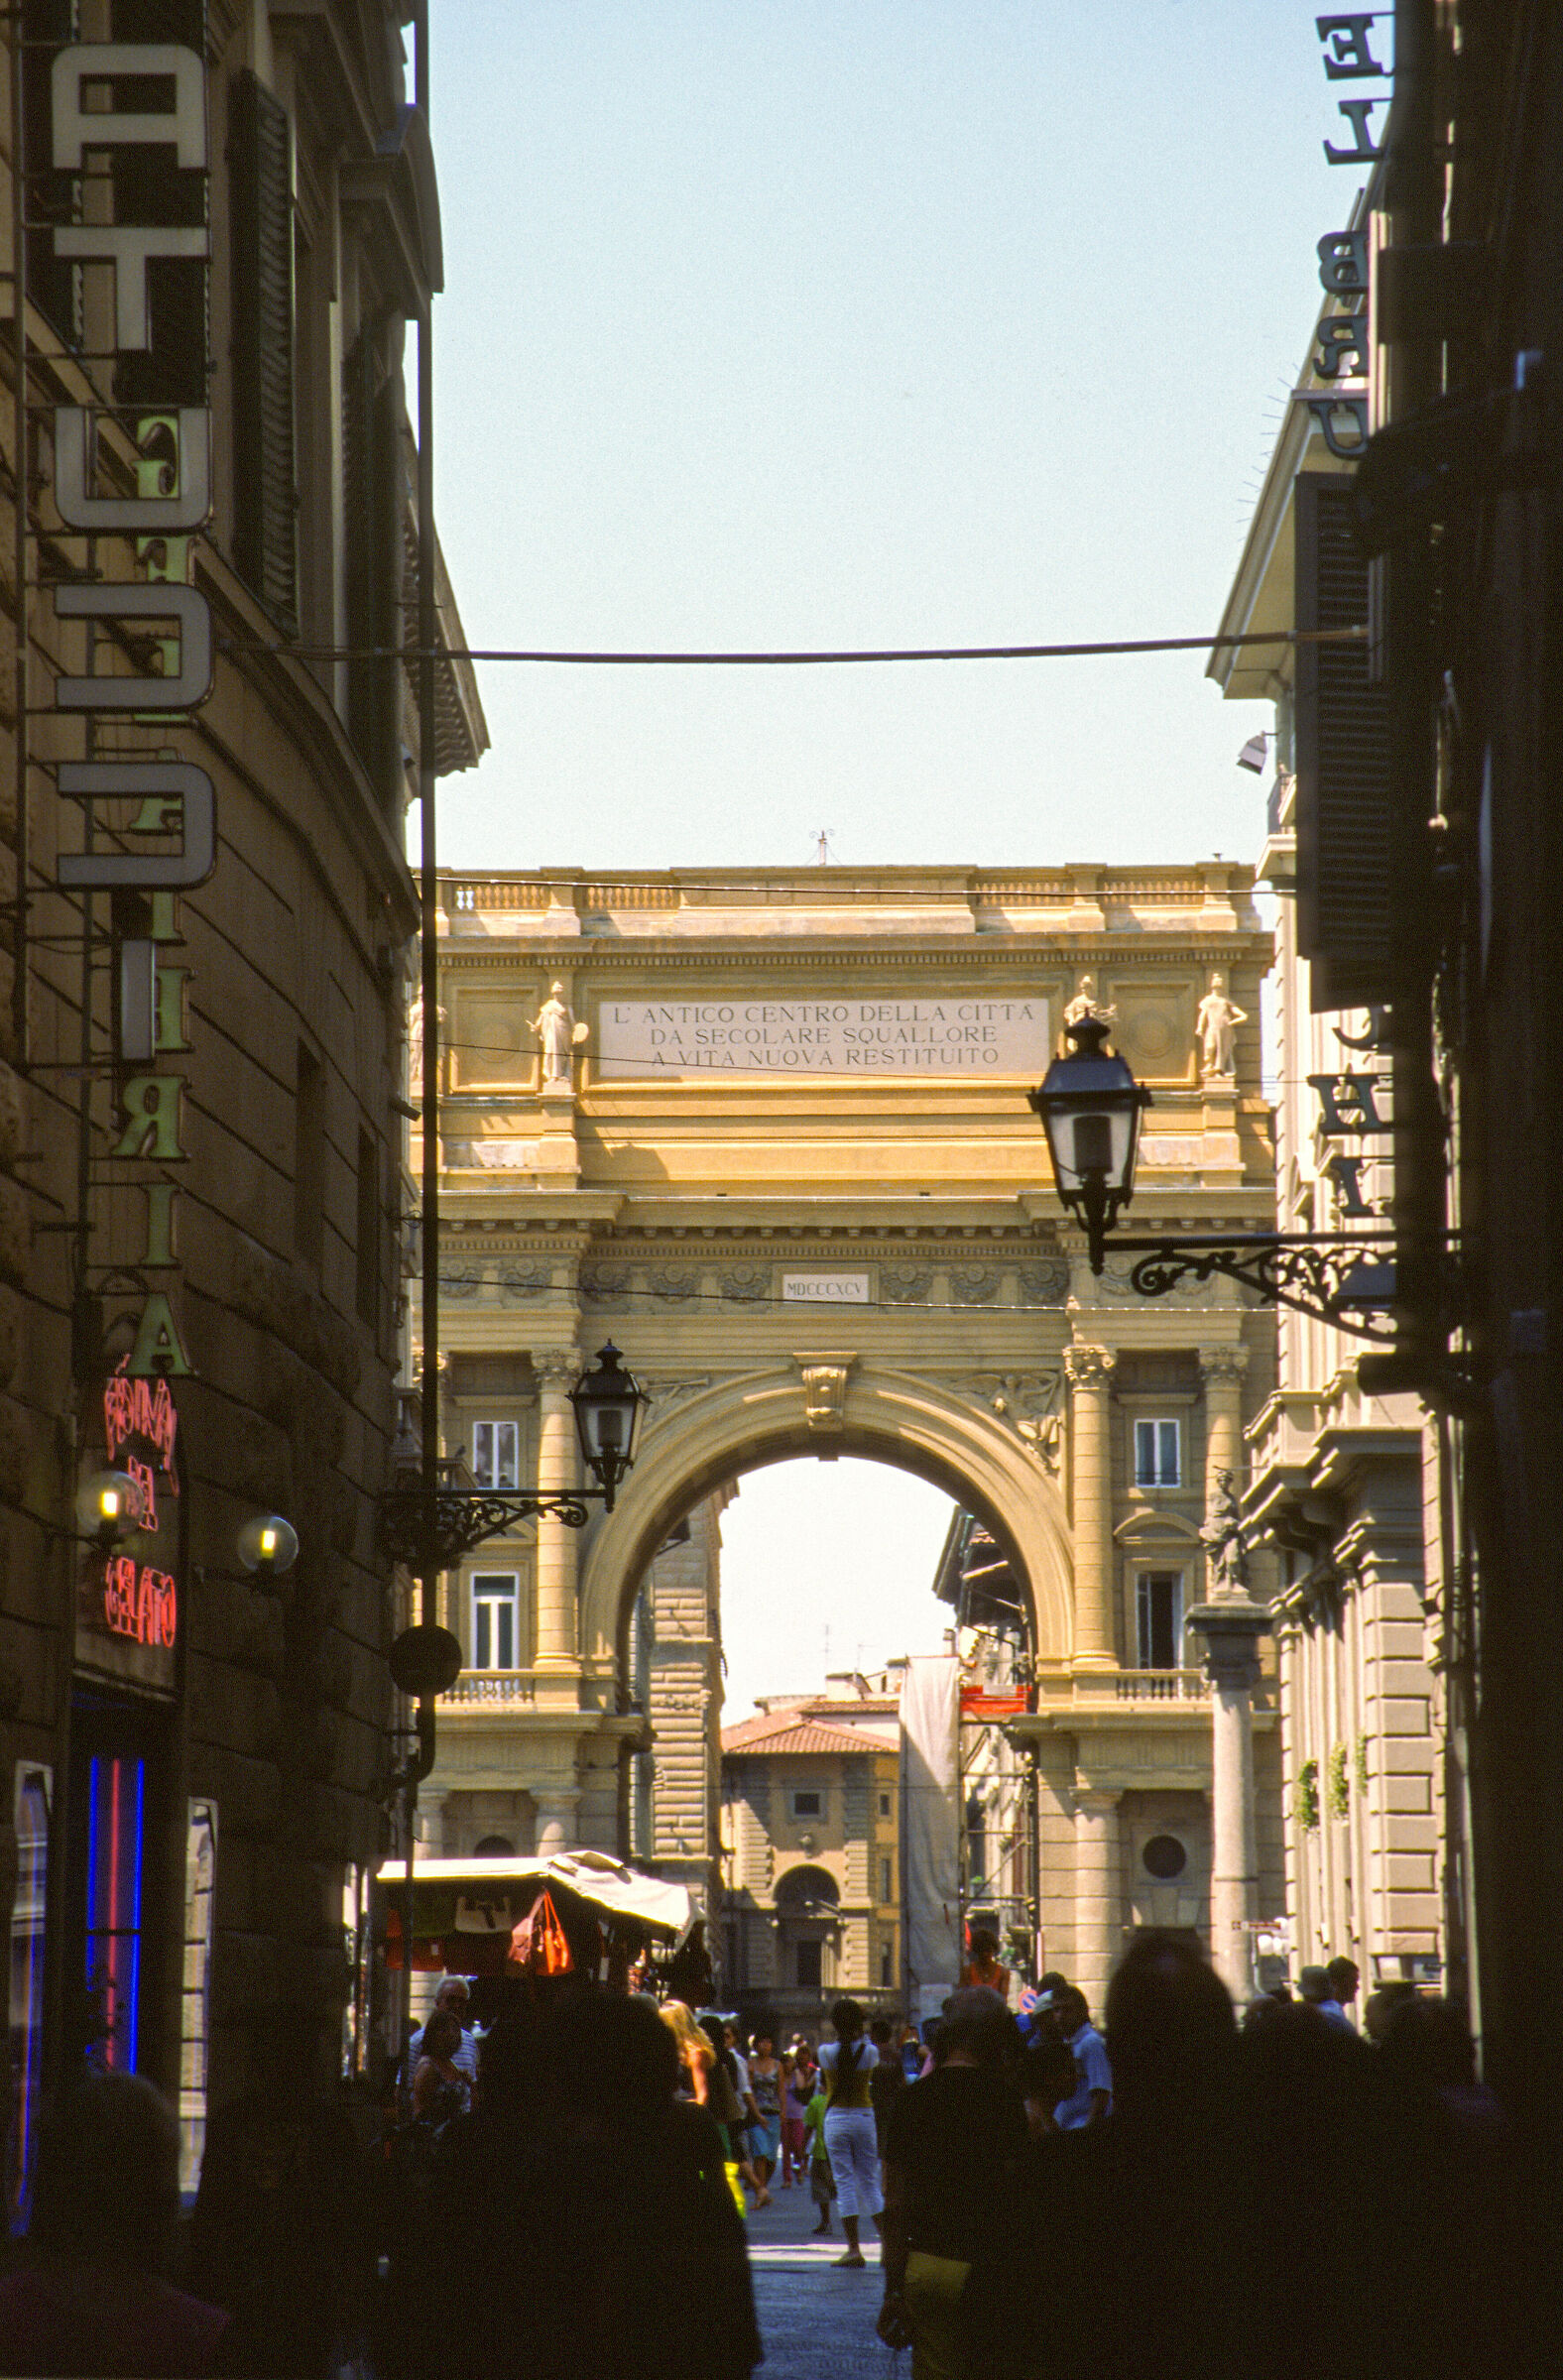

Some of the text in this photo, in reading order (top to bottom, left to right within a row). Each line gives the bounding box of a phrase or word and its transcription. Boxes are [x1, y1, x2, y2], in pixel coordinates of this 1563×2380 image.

[643, 1006, 735, 1023] ANTICO
[745, 1006, 849, 1023] CENTRO
[860, 1005, 946, 1022] DELLA
[651, 1026, 998, 1045] DA SECOLARE SQUALLORE
[652, 1048, 999, 1066] A VITA NUOVA RESTITUITO
[786, 1282, 862, 1296] MDCCCXCV
[104, 1556, 177, 1647] GELATO
